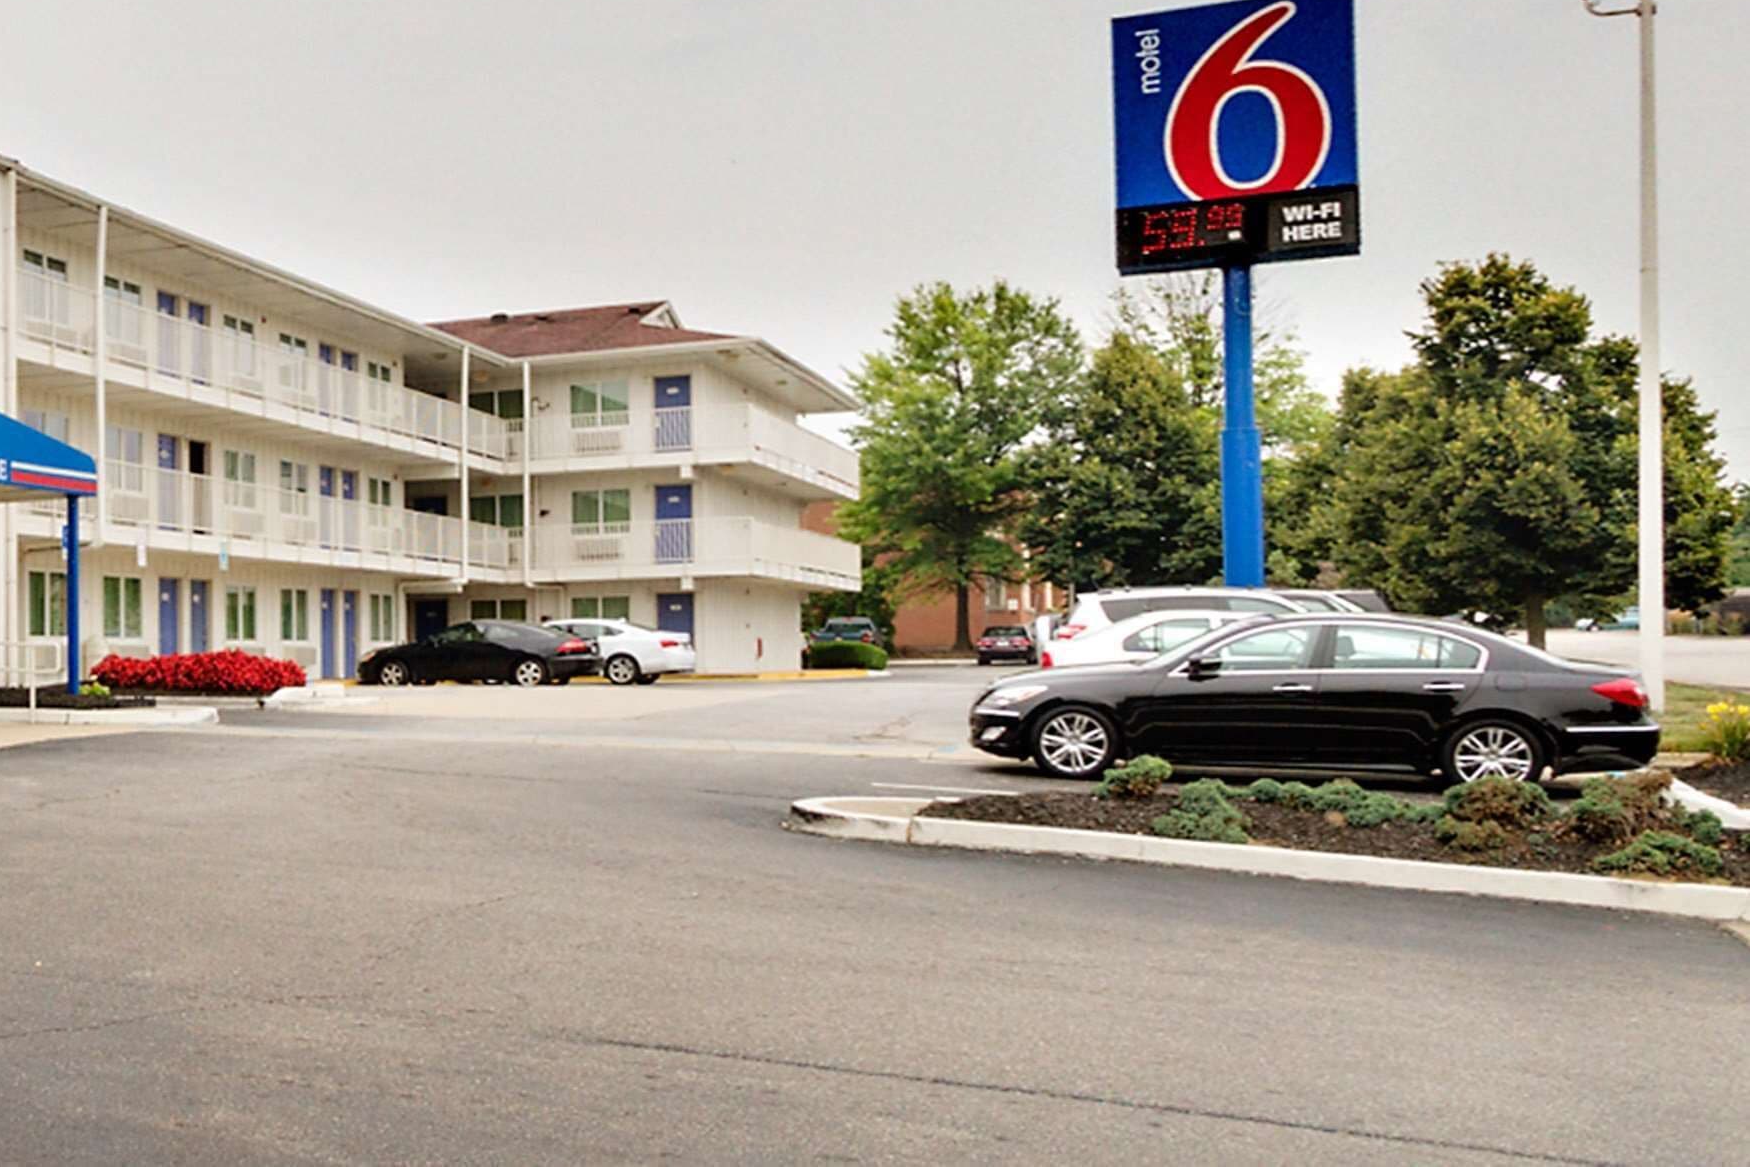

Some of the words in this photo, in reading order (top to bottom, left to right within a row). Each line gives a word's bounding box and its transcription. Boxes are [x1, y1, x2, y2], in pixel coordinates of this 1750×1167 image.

[1135, 28, 1162, 95] motel
[1164, 0, 1332, 201] 6
[1282, 202, 1342, 222] WI-FI
[1282, 222, 1342, 242] HERE
